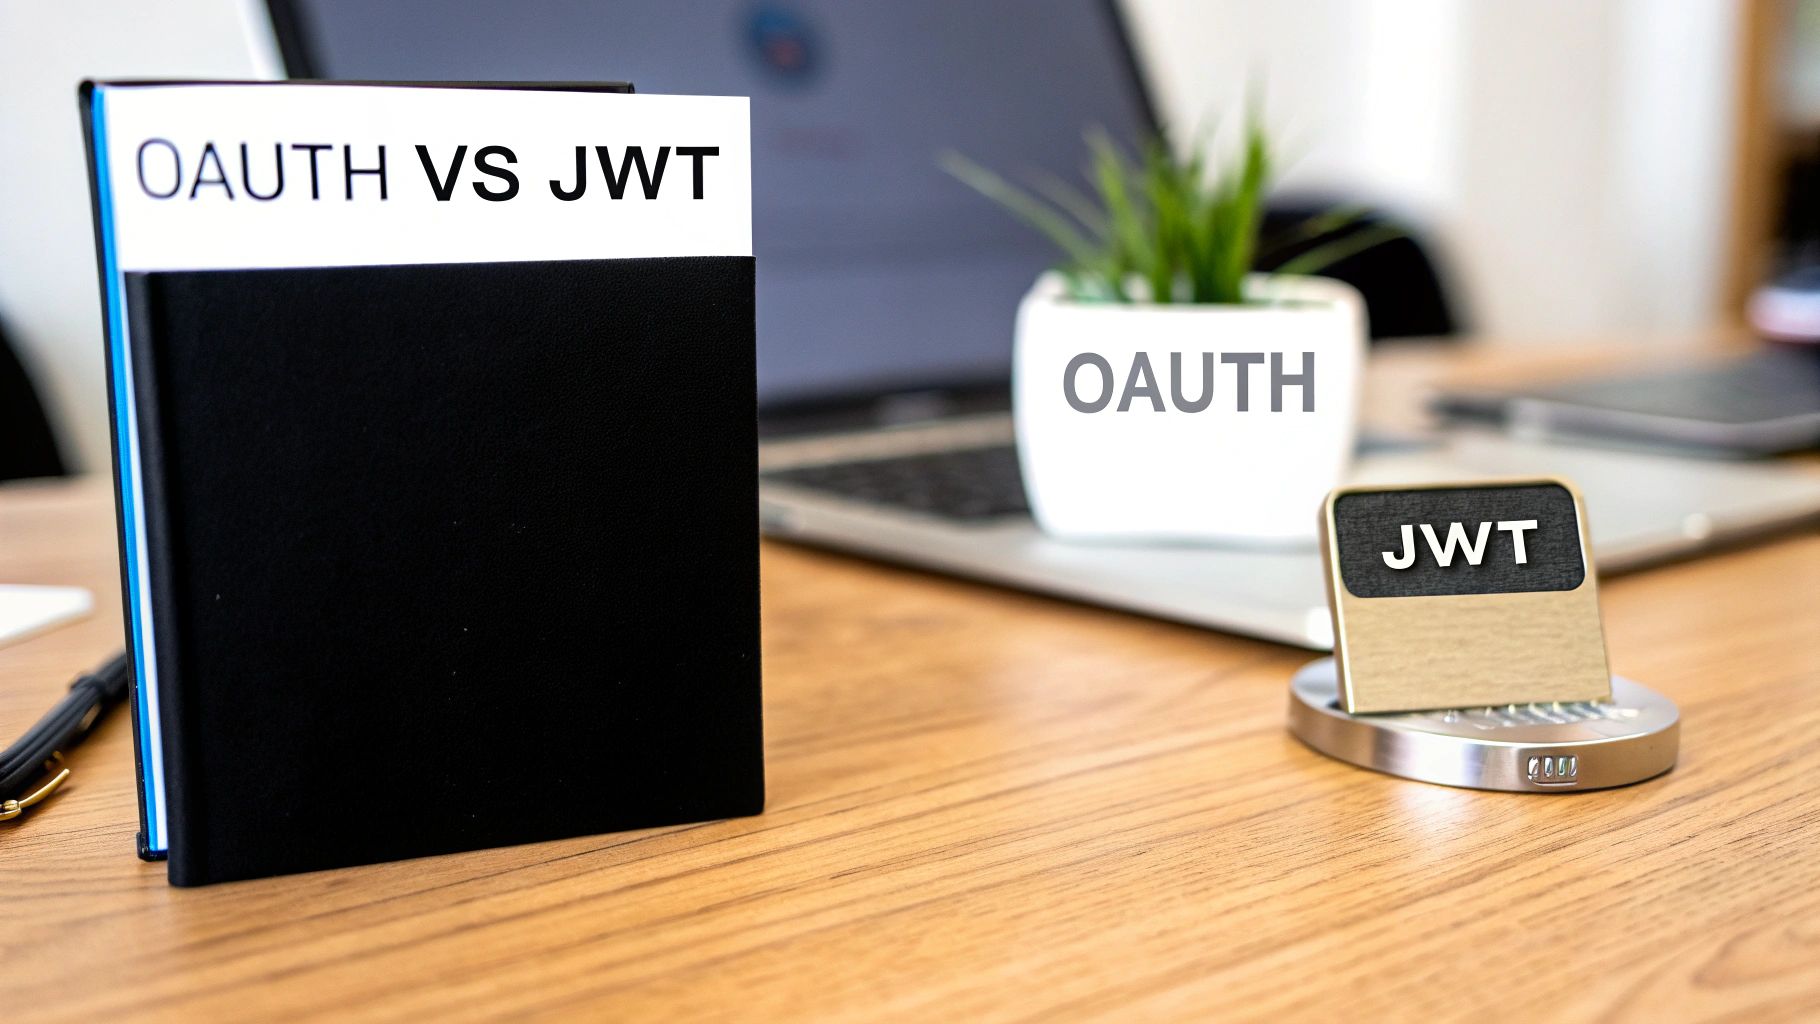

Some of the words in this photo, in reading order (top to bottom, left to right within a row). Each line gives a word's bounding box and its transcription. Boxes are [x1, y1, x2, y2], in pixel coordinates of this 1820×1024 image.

[135, 138, 388, 201] OAUTH
[414, 144, 520, 202] VS
[548, 145, 720, 201] JWT
[1063, 351, 1315, 413] OAUTH
[1381, 519, 1538, 570] JWT
